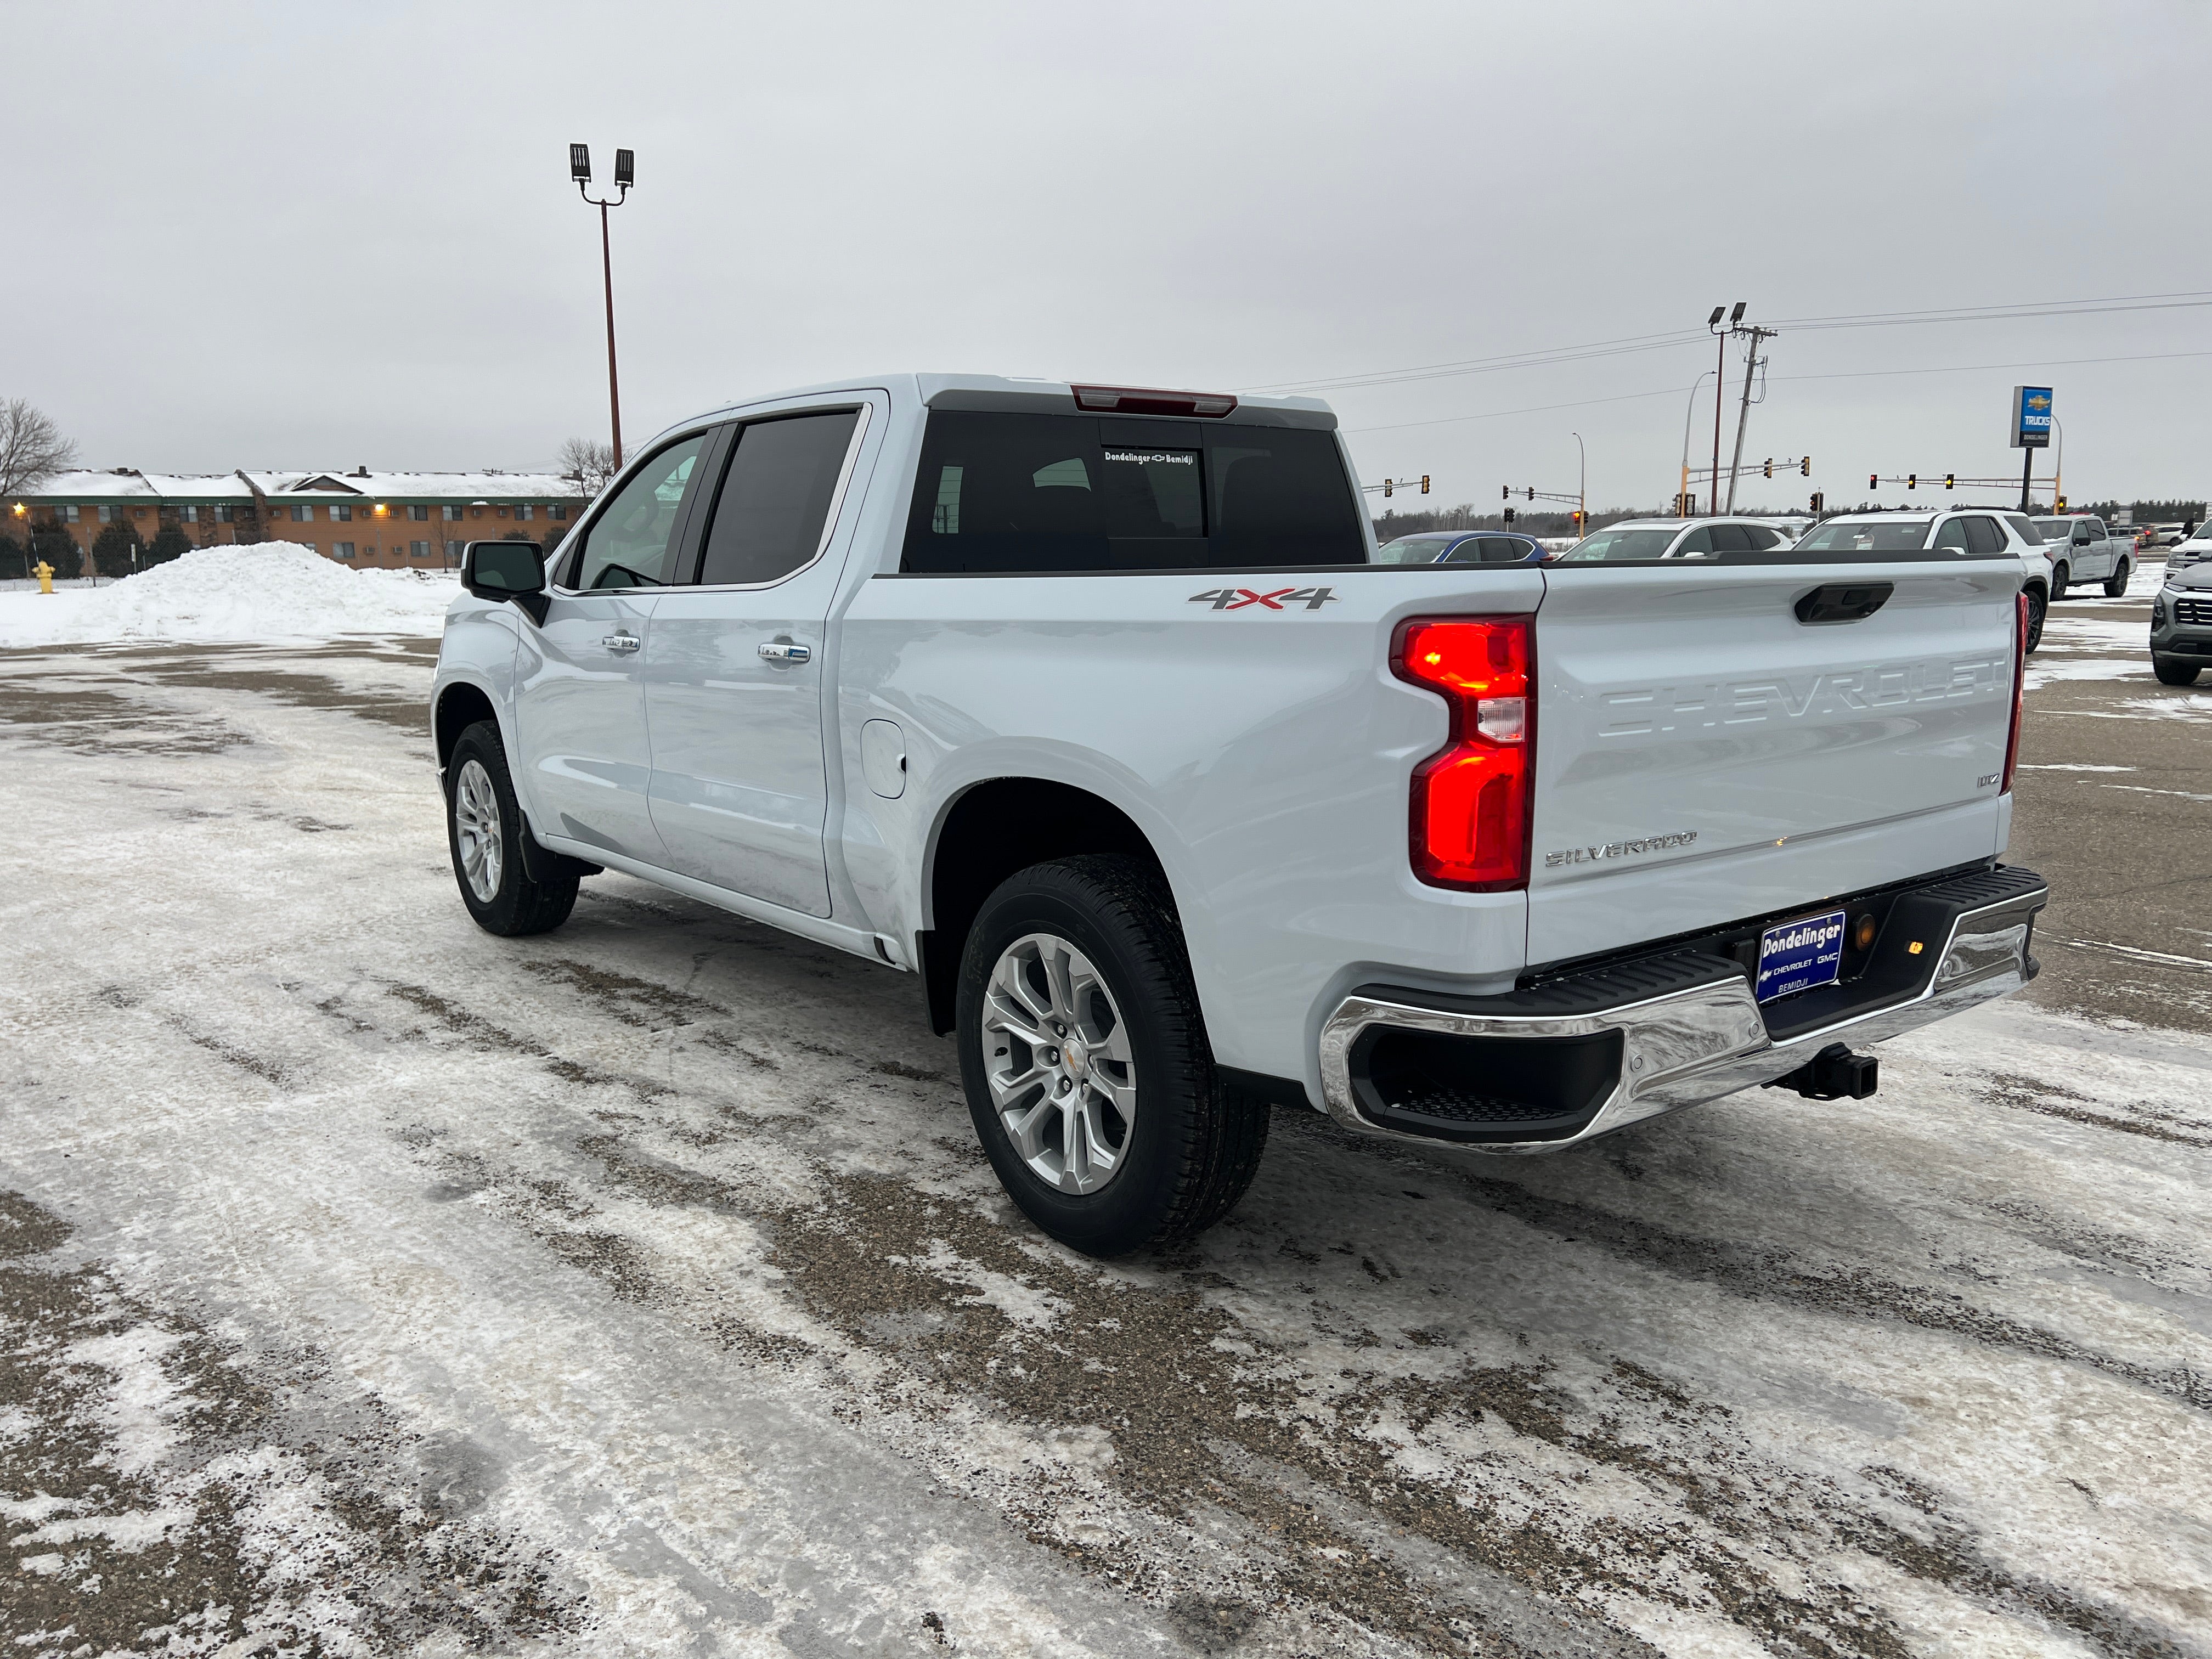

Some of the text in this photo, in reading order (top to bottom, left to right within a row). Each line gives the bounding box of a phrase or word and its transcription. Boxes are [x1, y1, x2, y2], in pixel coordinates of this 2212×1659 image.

[2025, 415, 2051, 426] TRUCKS
[1105, 452, 1193, 465] Dondelinger Bemidji
[1598, 656, 2006, 737] CHEVROLET
[1977, 773, 2000, 788] LTZ
[1545, 830, 1697, 867] SILVERADO
[1763, 924, 1841, 958] Dondelinger
[1773, 952, 1838, 975] CHEVROLET GMC
[1778, 978, 1808, 994] BEMIDJI
